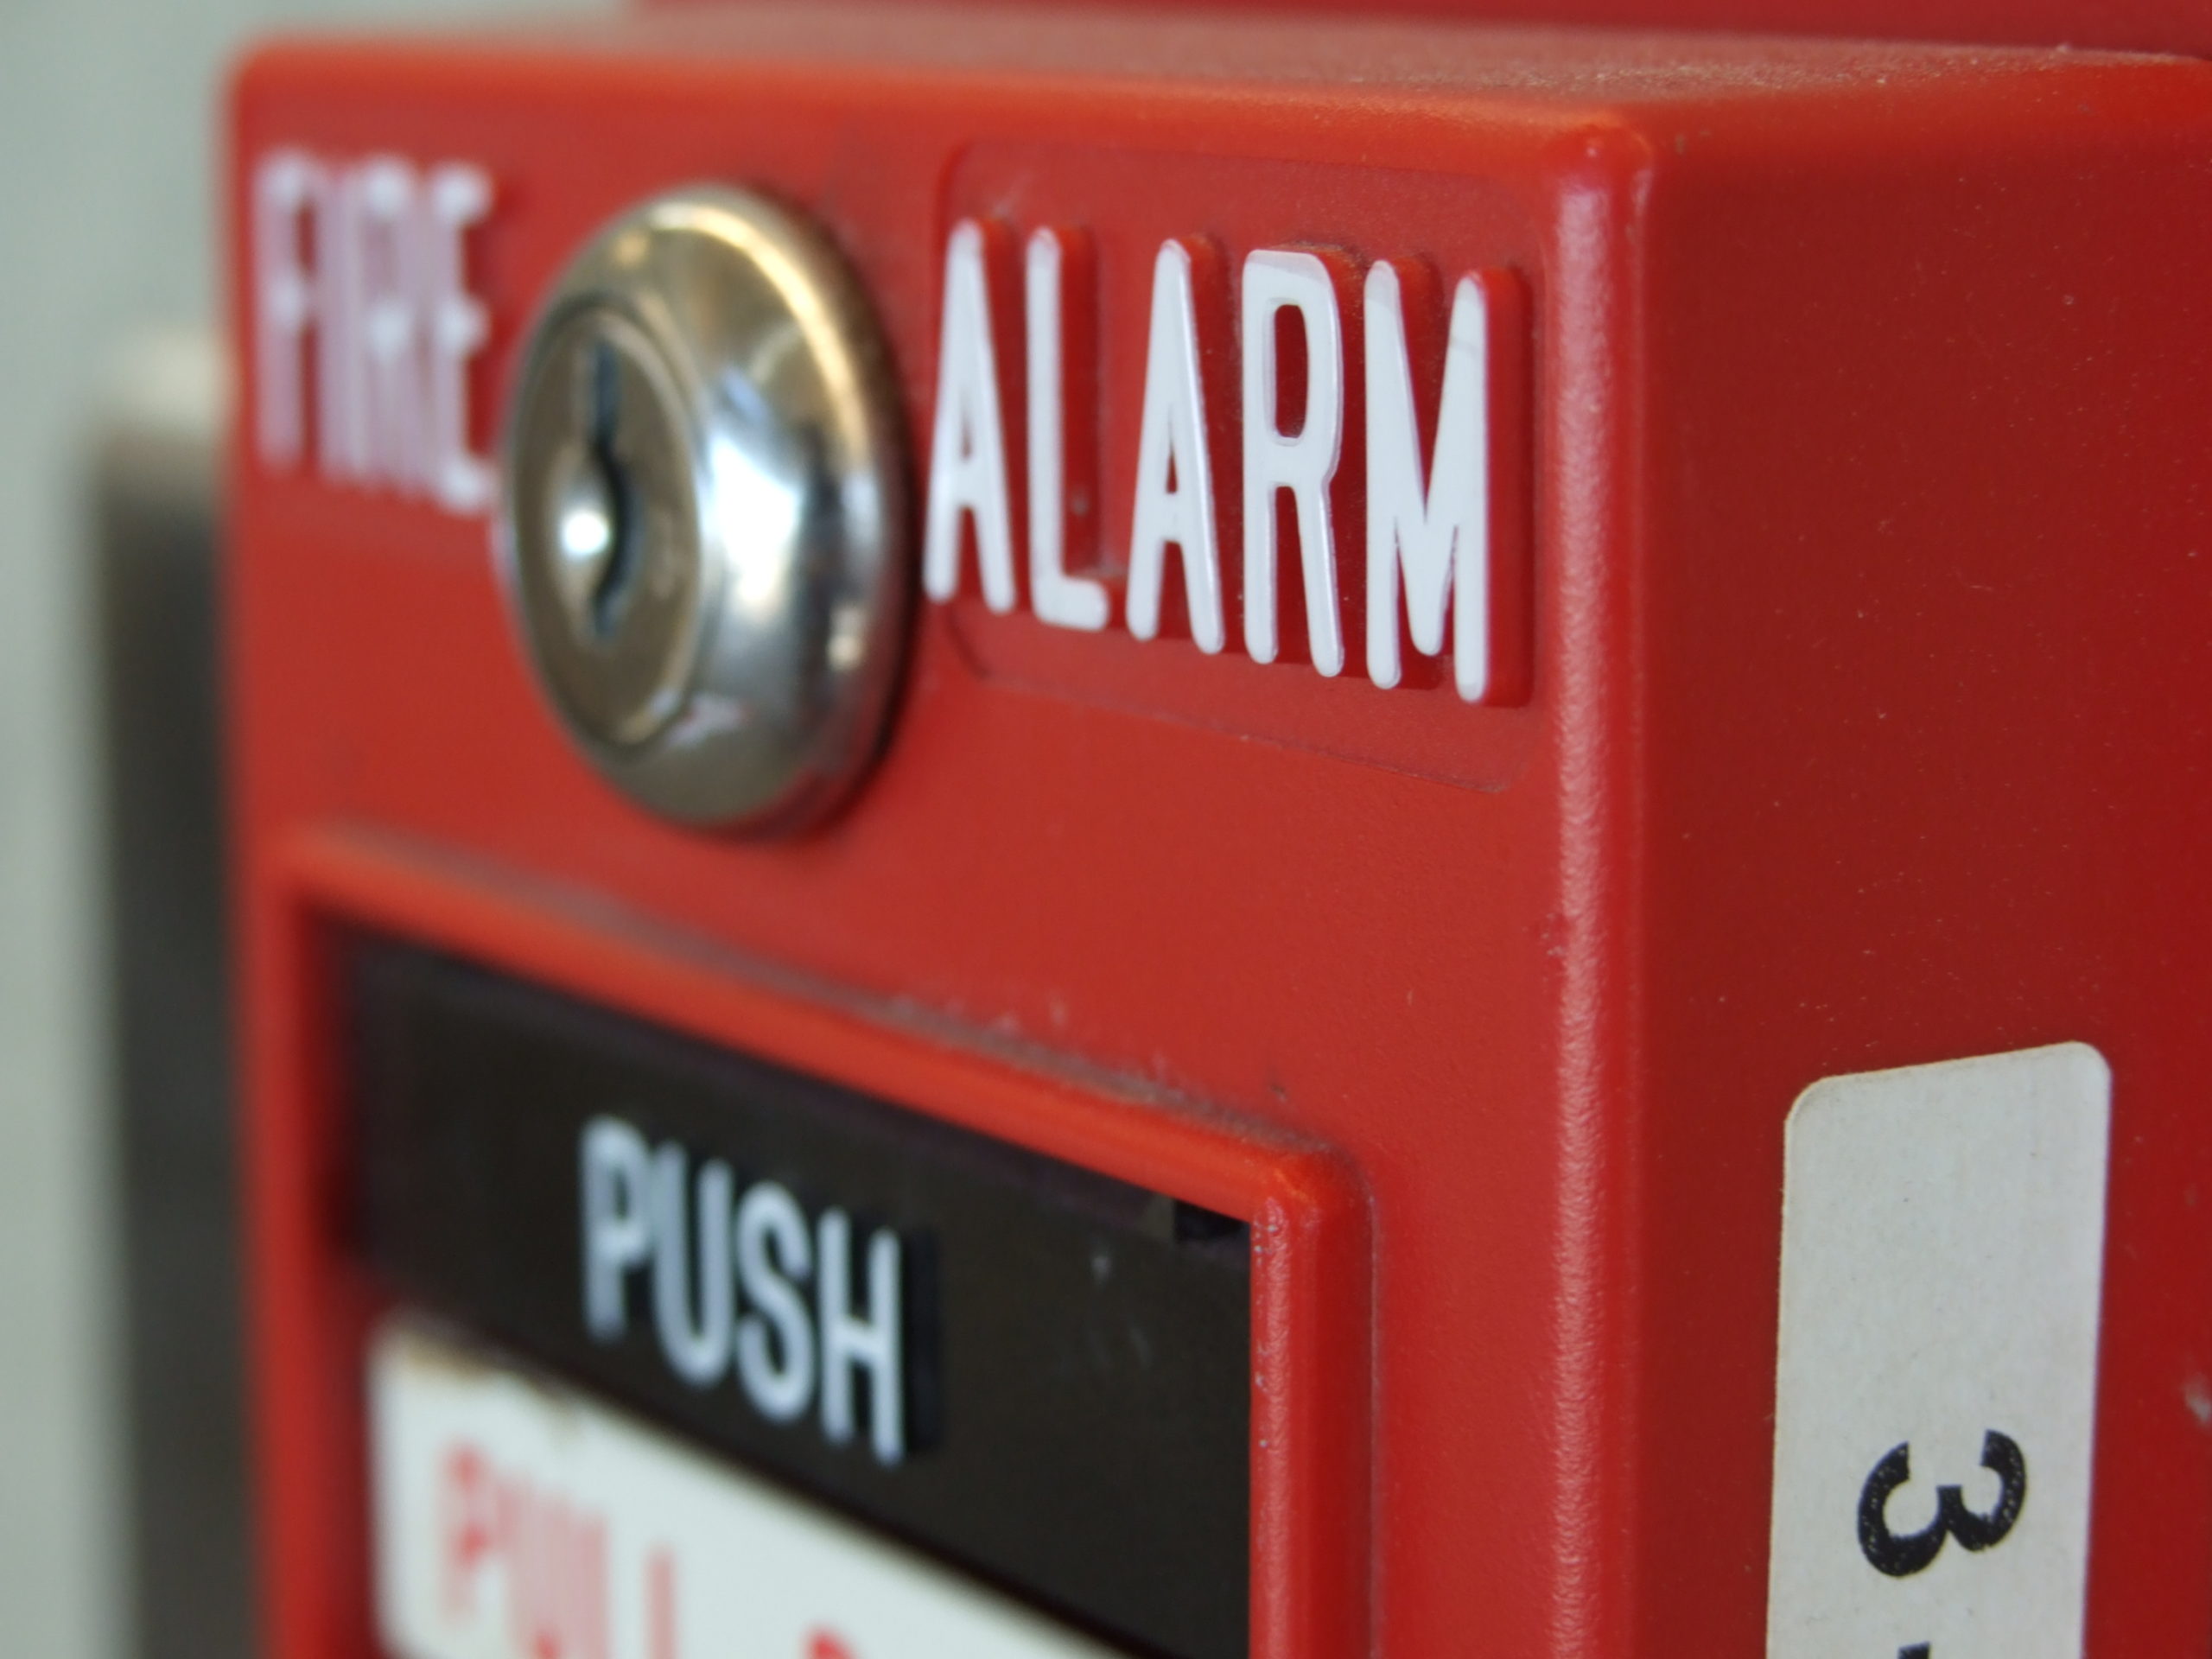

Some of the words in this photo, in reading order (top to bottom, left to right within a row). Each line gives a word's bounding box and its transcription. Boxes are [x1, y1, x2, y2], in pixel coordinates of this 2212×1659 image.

[254, 149, 499, 512] FIRE
[925, 218, 1490, 703] ALARM
[579, 1115, 905, 1466] PUSH
